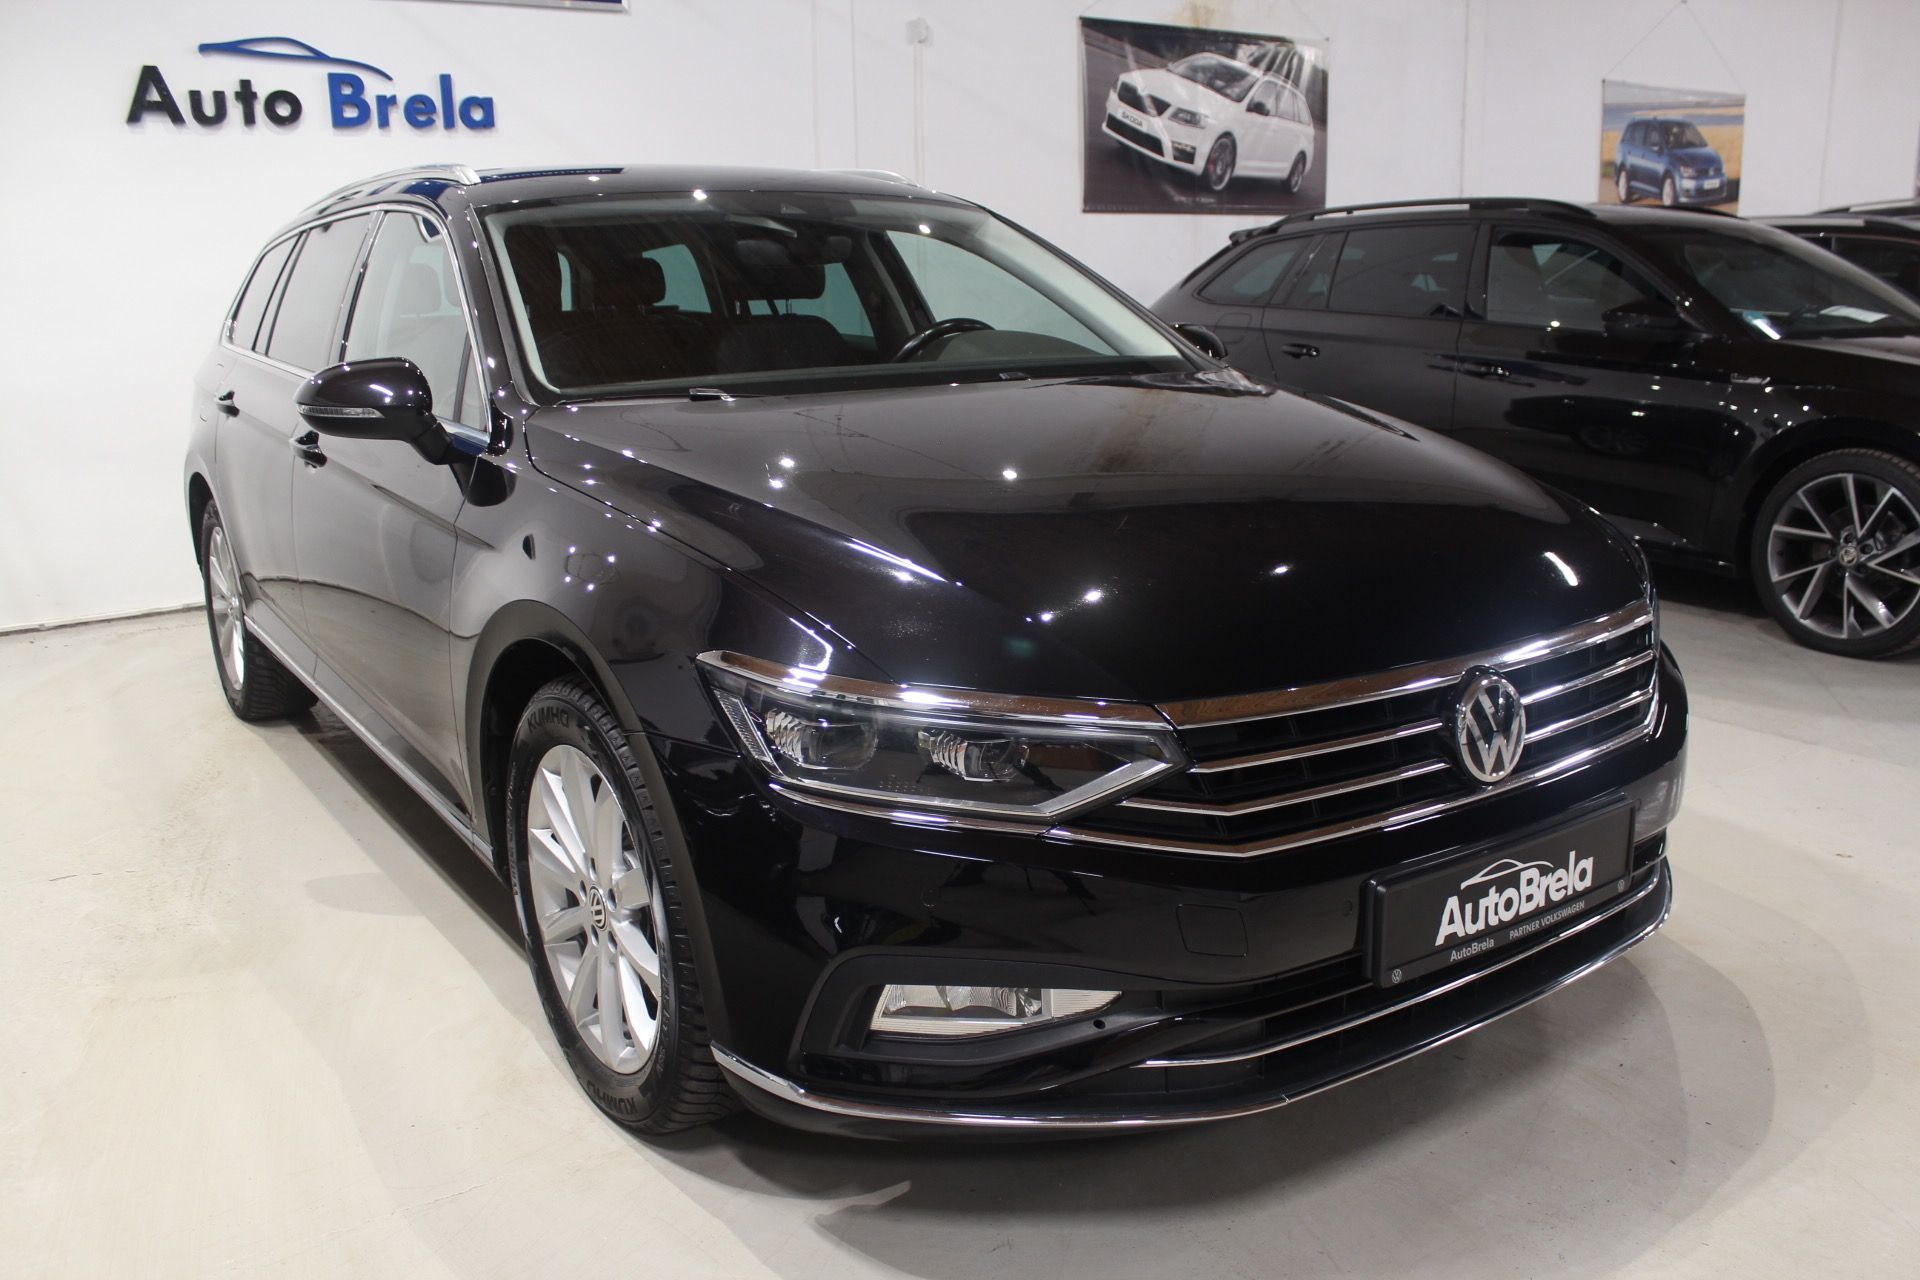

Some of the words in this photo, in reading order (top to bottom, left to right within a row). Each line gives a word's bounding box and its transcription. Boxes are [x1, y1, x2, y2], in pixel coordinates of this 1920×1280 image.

[126, 64, 303, 127] Auto
[327, 72, 496, 131] Brela
[1435, 850, 1594, 947] AutoBrela
[1450, 937, 1495, 962] AutoBrela
[1509, 920, 1540, 940] PARTNER
[1541, 901, 1585, 929] VOLKSWAGEN
